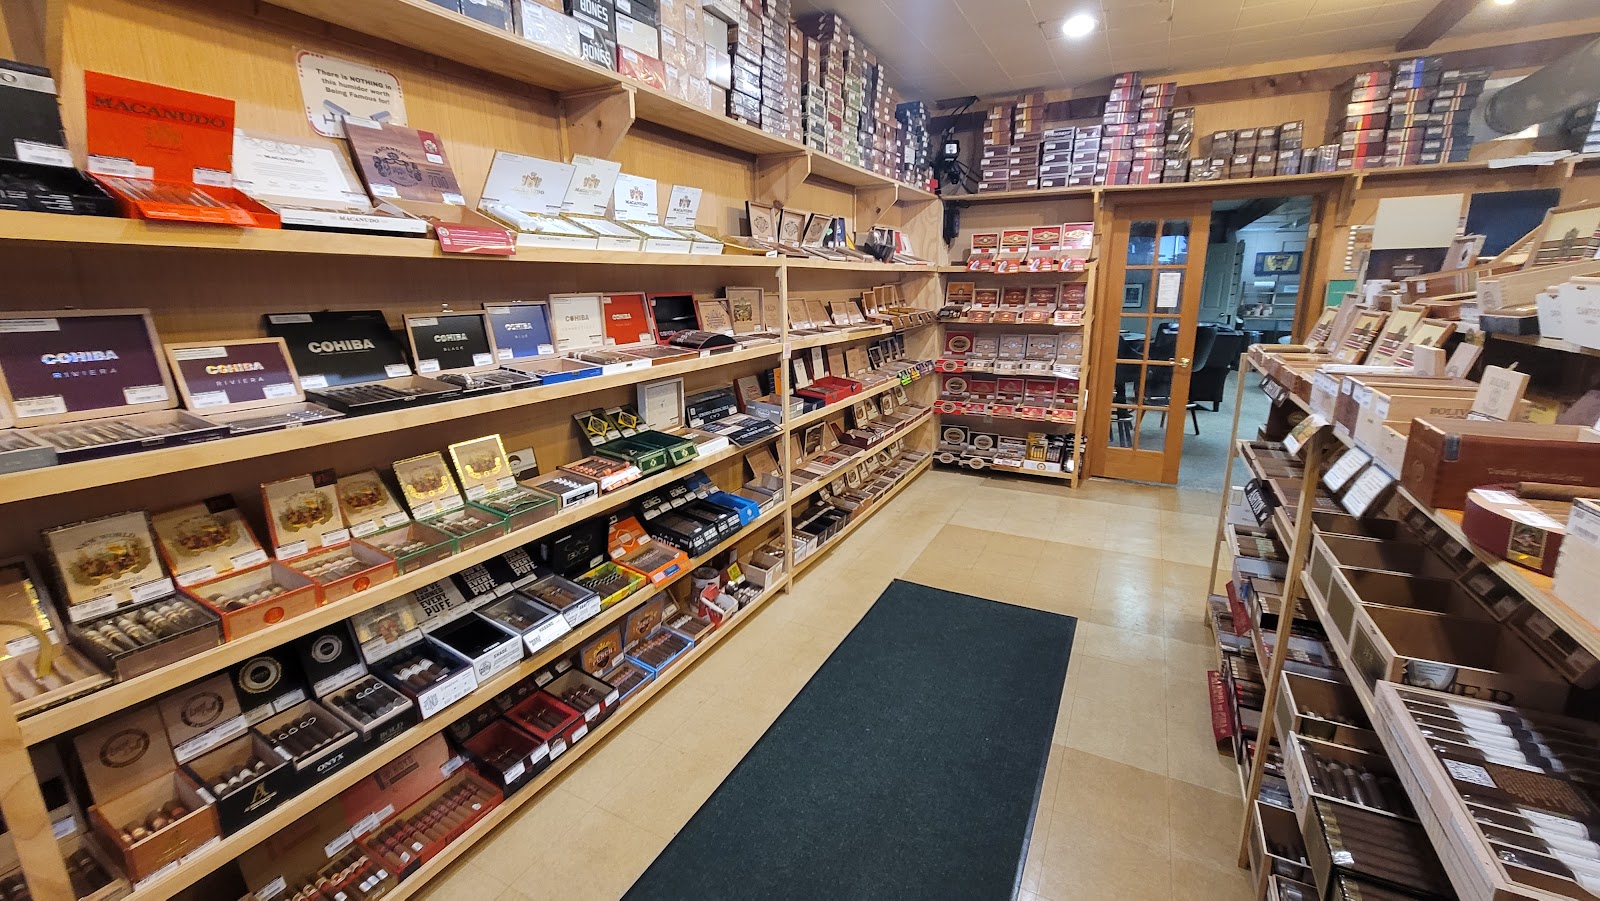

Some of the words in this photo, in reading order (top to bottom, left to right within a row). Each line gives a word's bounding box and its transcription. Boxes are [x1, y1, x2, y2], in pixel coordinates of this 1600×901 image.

[582, 42, 611, 65] BONES
[315, 68, 339, 79] There
[349, 76, 384, 89] NOTHING
[322, 78, 337, 86] this
[338, 82, 368, 93] humidor
[370, 89, 390, 98] worth
[325, 86, 348, 97] Being
[349, 91, 377, 102] Famous
[93, 94, 226, 129] MACANUDO
[264, 154, 304, 164] MACANUDO
[428, 175, 449, 189] 2010
[625, 199, 648, 207] MACANUDO
[339, 214, 379, 223] MACANUDO
[565, 314, 590, 322] COHIBA
[504, 322, 534, 331] COHIBA
[433, 332, 469, 343] COHIBA
[307, 339, 376, 354] COHIBA
[41, 350, 119, 365] COHIBA
[52, 368, 118, 379] RIVIERA
[205, 361, 265, 375] COHIBA
[216, 377, 265, 386] RIVIERA
[1429, 406, 1469, 417] BOLIV
[1248, 489, 1267, 516] ASHTON
[509, 556, 534, 570] EVERY
[513, 561, 538, 577] PUFF
[467, 572, 493, 589] EVERY
[471, 580, 498, 596] PUFF
[420, 592, 448, 609] EVERY
[424, 599, 453, 617] PUFF
[317, 752, 345, 772] ONYX
